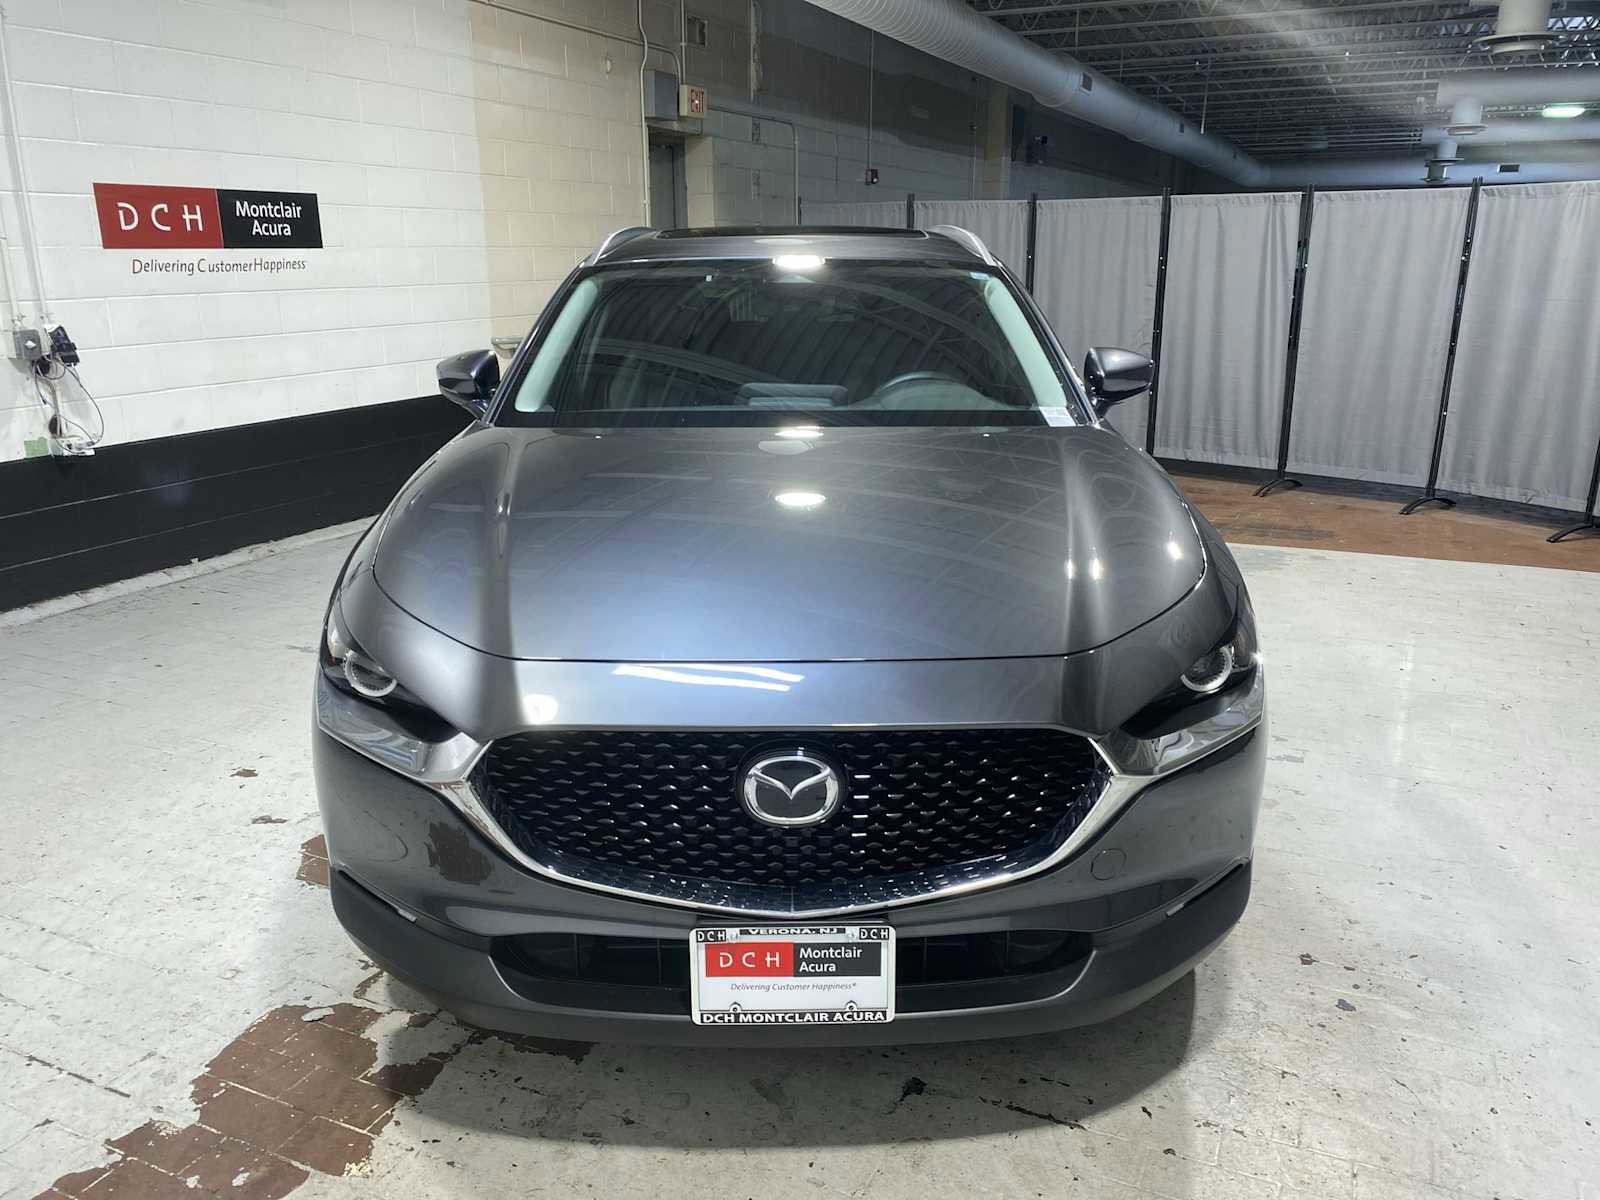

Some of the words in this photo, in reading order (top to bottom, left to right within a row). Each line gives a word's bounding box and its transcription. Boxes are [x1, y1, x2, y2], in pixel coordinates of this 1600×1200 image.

[690, 88, 704, 112] EXIT
[235, 200, 302, 219] Montclair
[117, 202, 204, 232] DCH
[251, 220, 292, 236] Acura
[132, 258, 195, 276] Delivering
[197, 258, 253, 273] Customer
[253, 257, 306, 274] Happiness
[697, 930, 726, 942] DCH
[860, 928, 889, 940] DCH
[799, 946, 863, 959] Montclair
[719, 952, 780, 968] DCH
[799, 961, 836, 973] Acura
[731, 983, 770, 992] Delivering
[772, 983, 810, 991] Customer
[703, 1013, 735, 1024] DCH
[739, 1012, 829, 1023] MONTCLAIR
[833, 1011, 885, 1022] ACURA
